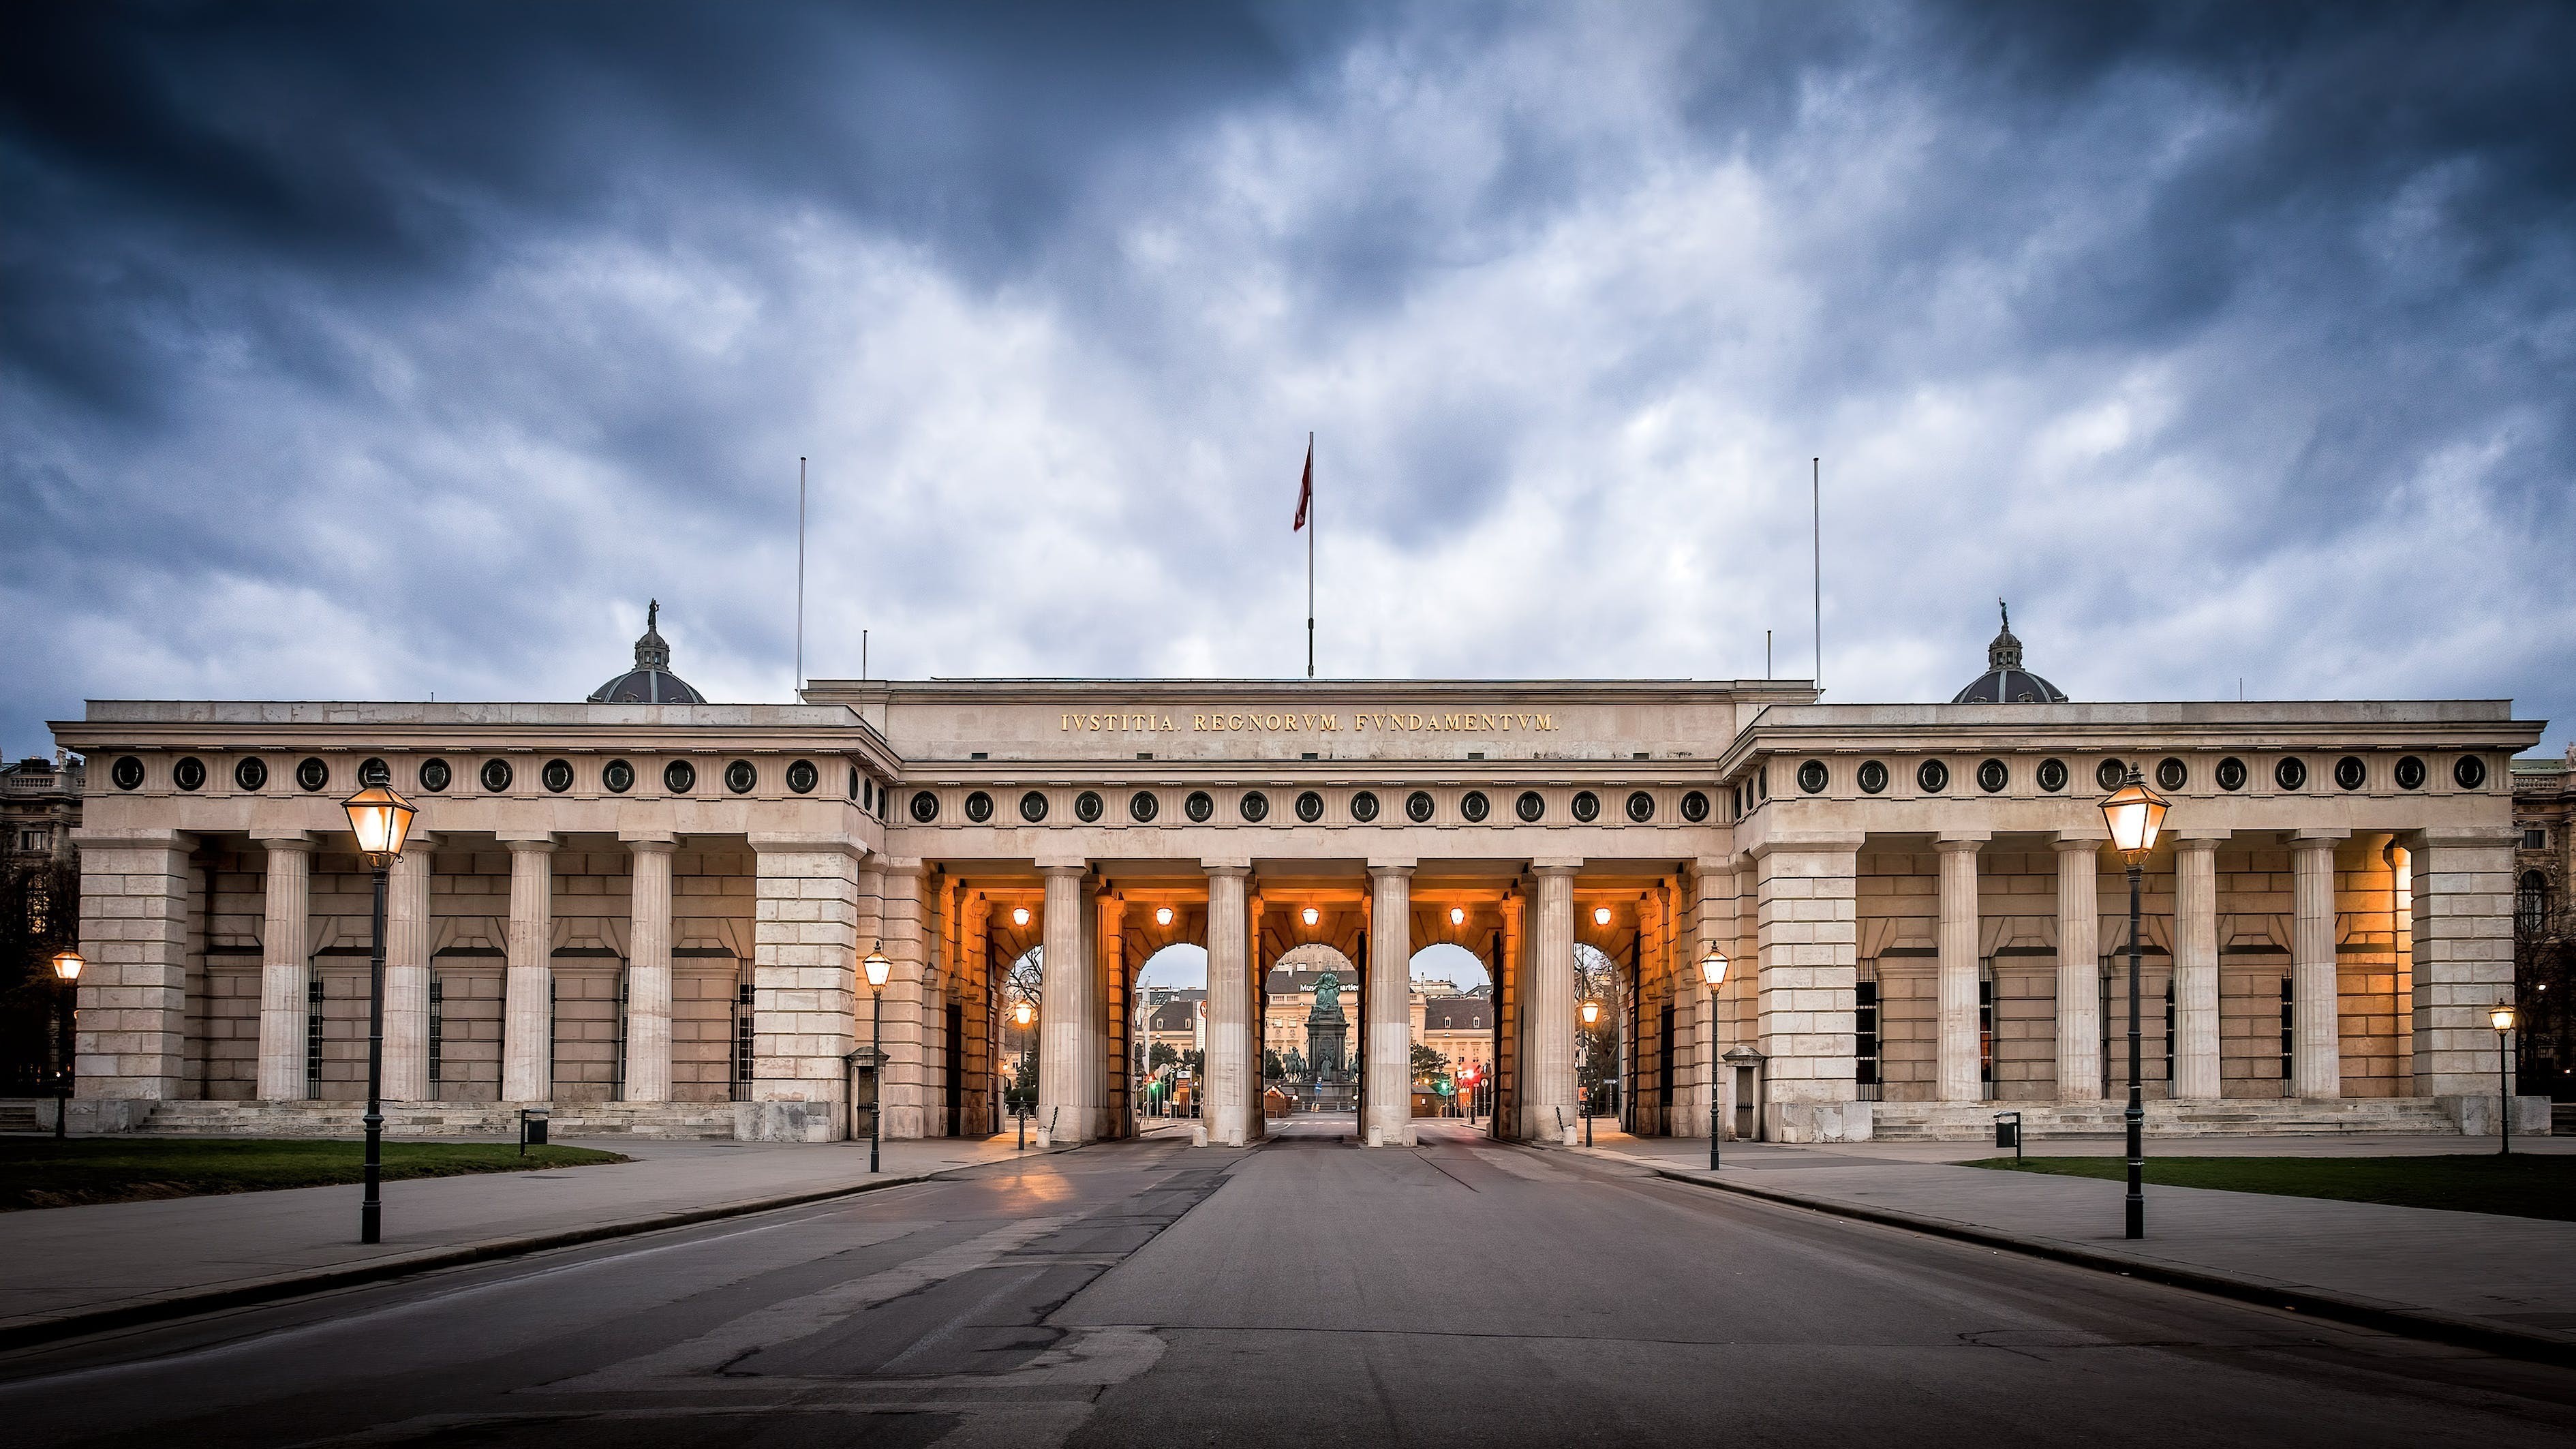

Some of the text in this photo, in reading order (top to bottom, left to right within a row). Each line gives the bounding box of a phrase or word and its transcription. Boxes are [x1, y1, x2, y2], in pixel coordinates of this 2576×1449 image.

[1061, 714, 1559, 731] IVSTITIA. REGNORVM. FVNDAMENTVM.
